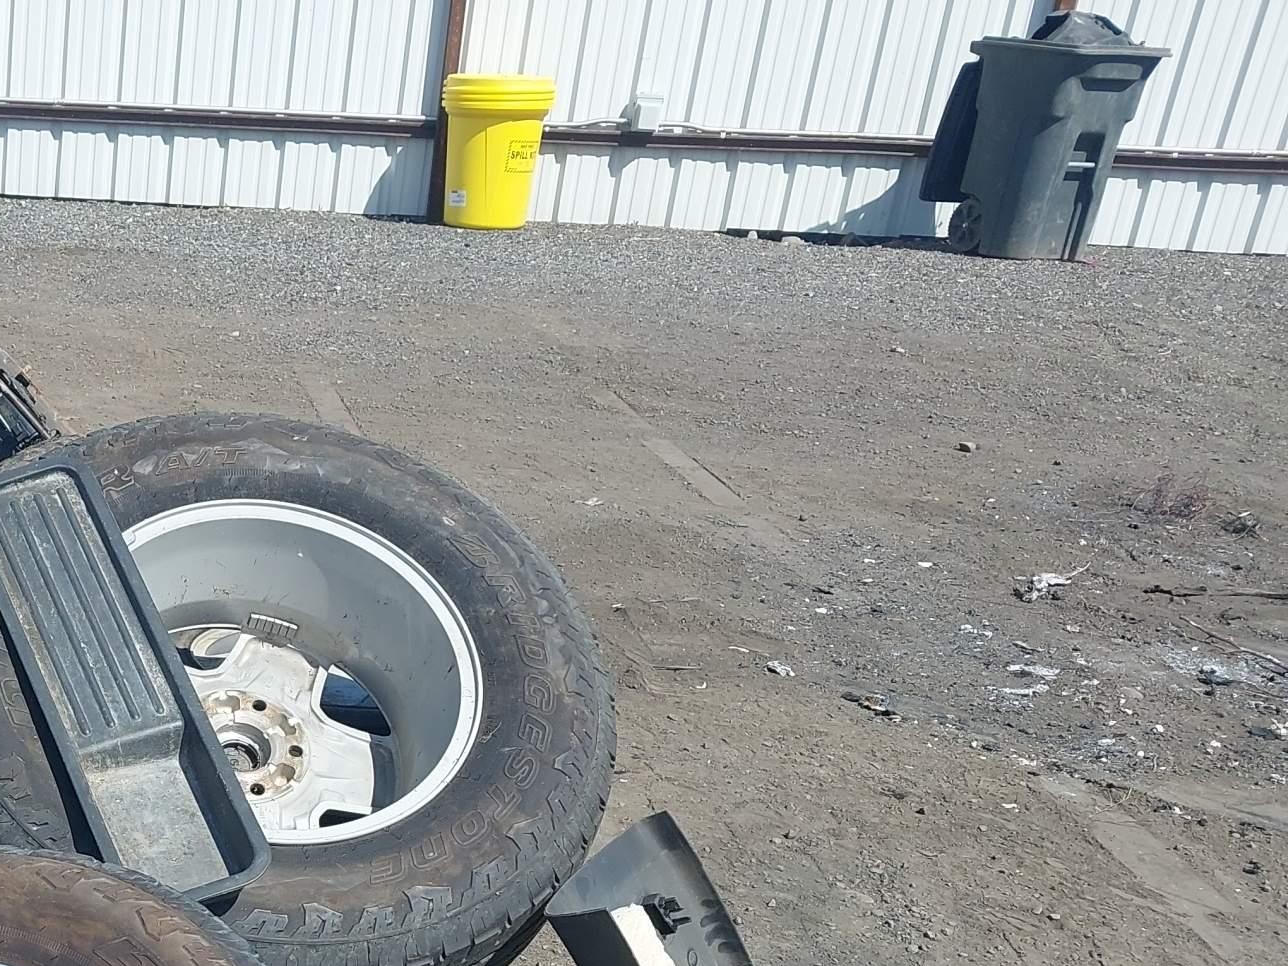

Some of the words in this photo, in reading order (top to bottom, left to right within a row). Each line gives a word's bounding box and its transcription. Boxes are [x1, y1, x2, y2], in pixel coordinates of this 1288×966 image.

[511, 150, 528, 160] SPILL
[155, 446, 248, 476] A/T
[369, 532, 554, 886] BRIDGESTONE
